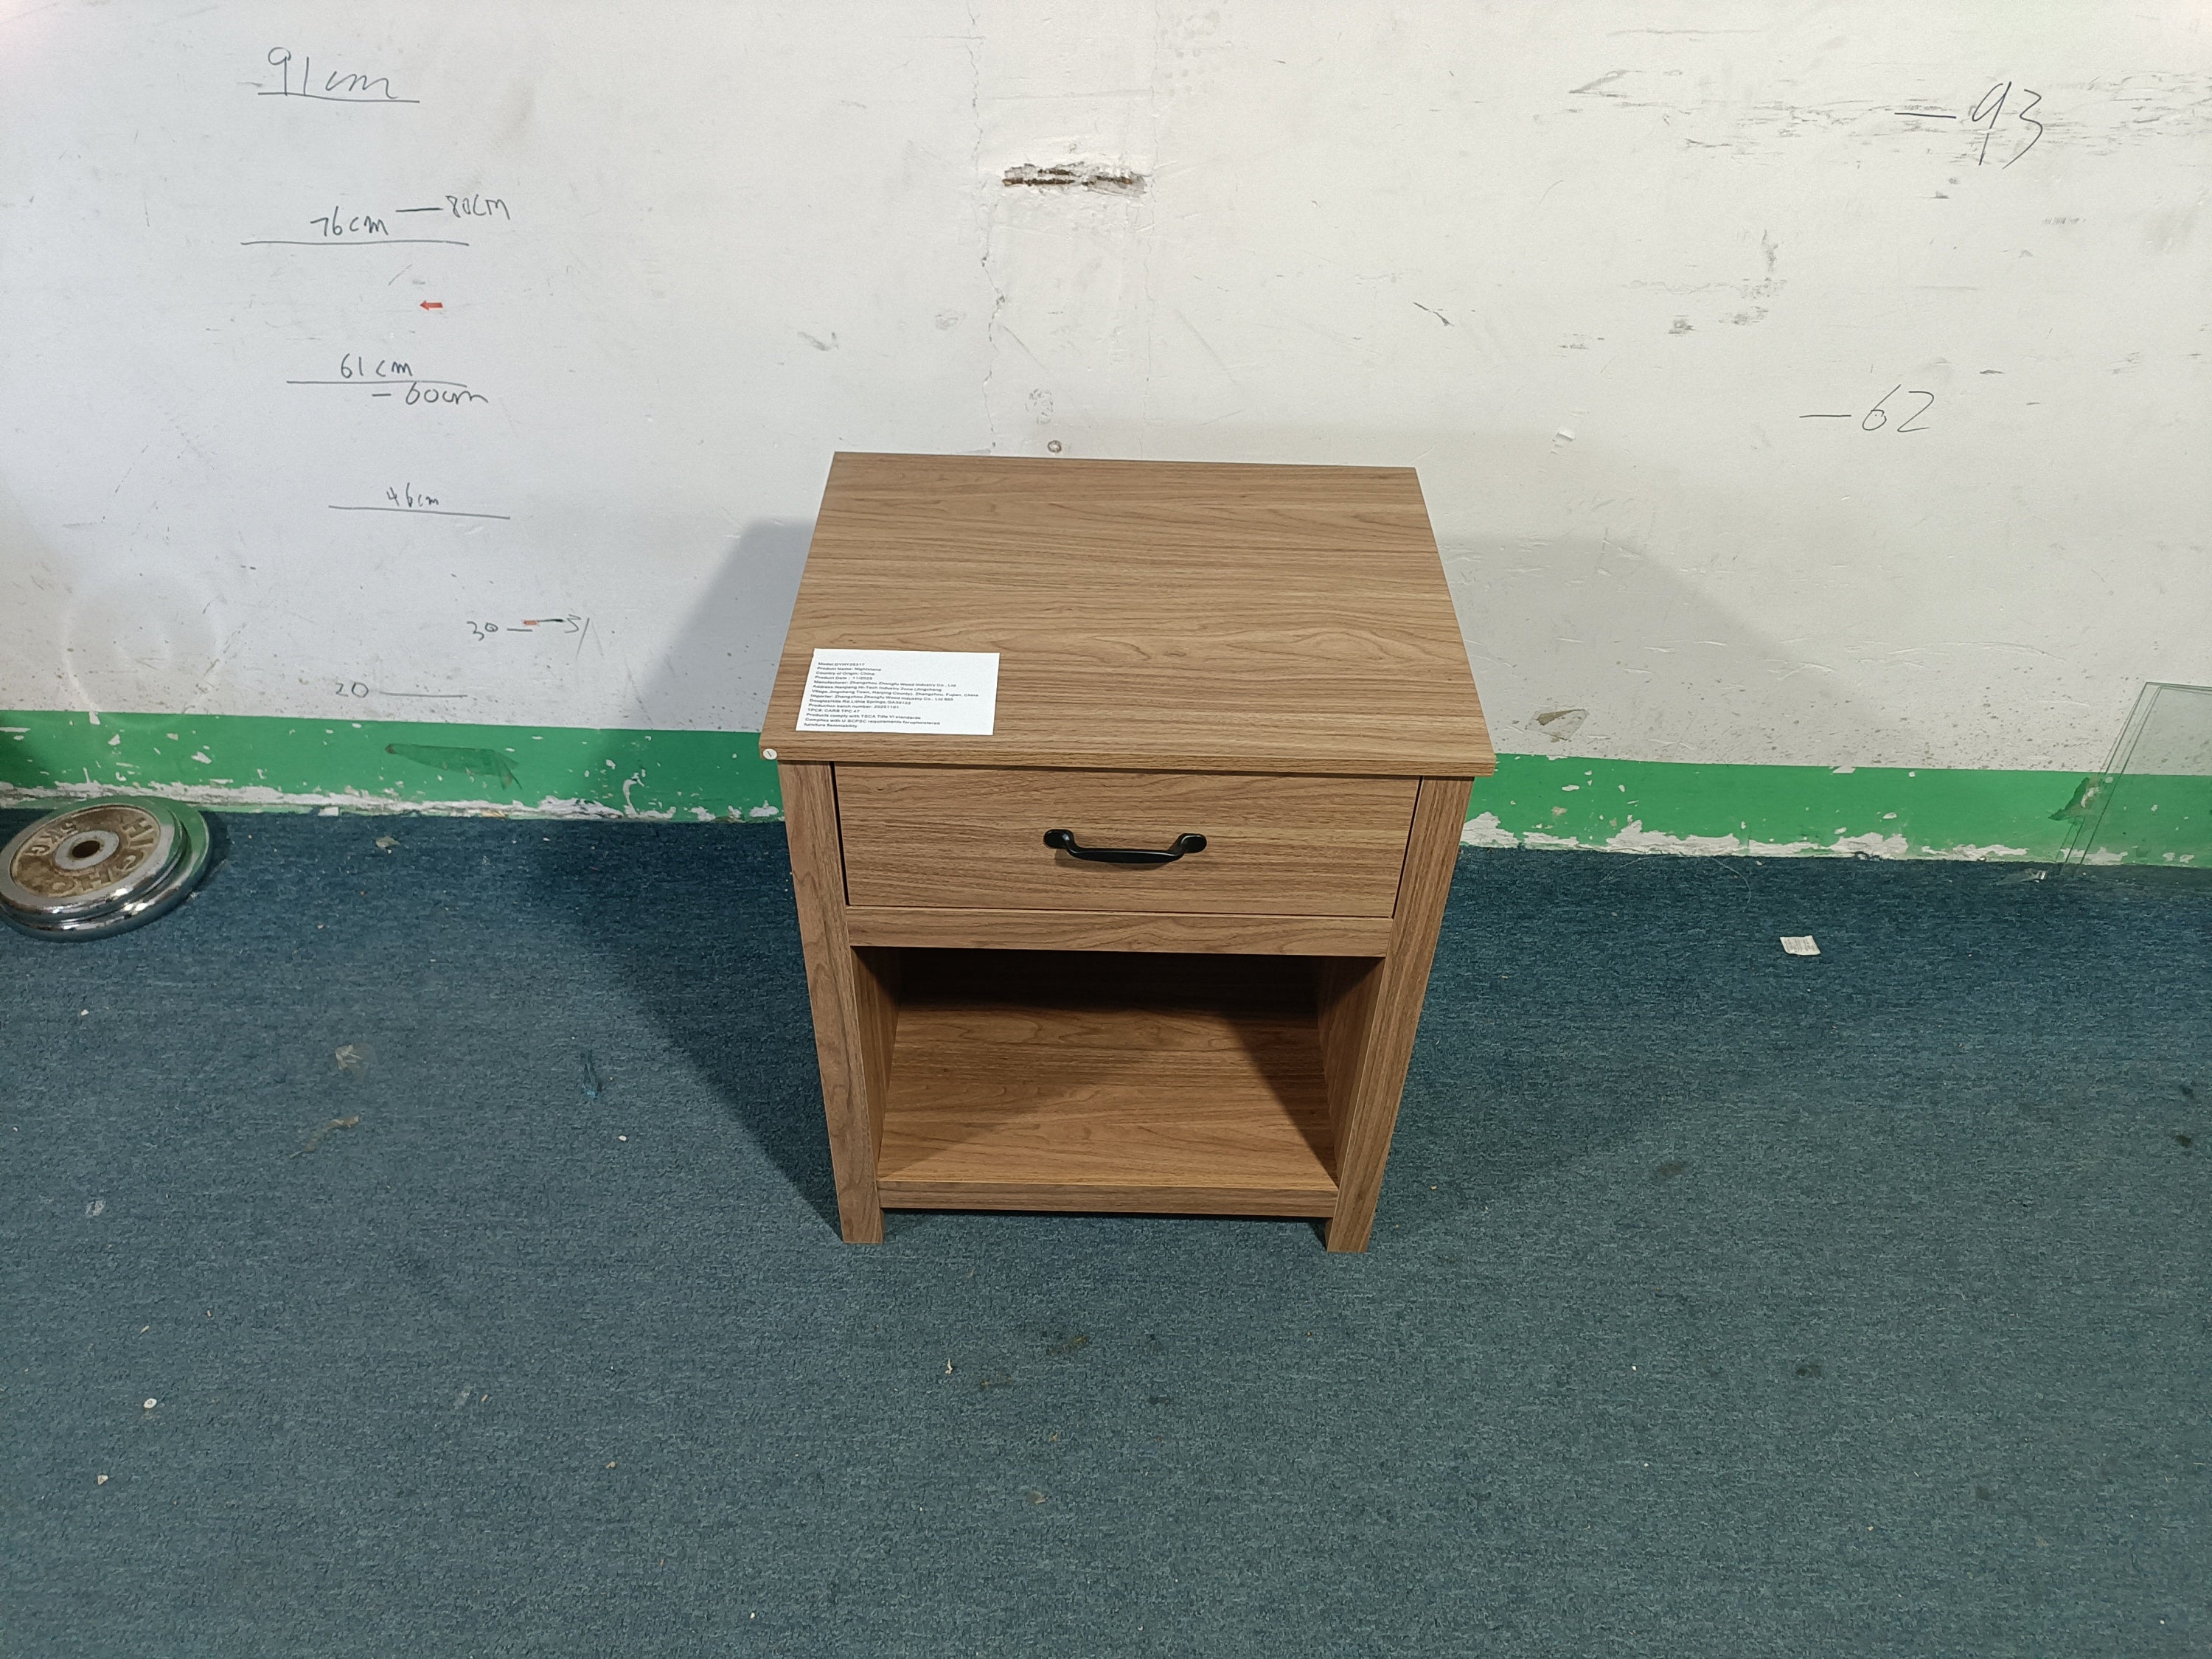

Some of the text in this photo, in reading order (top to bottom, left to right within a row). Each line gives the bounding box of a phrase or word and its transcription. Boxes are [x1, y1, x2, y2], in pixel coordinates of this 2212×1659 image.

[1972, 81, 2044, 170] 93
[310, 206, 389, 237] 76cm
[1862, 383, 1935, 433] 62
[334, 681, 369, 698] 20
